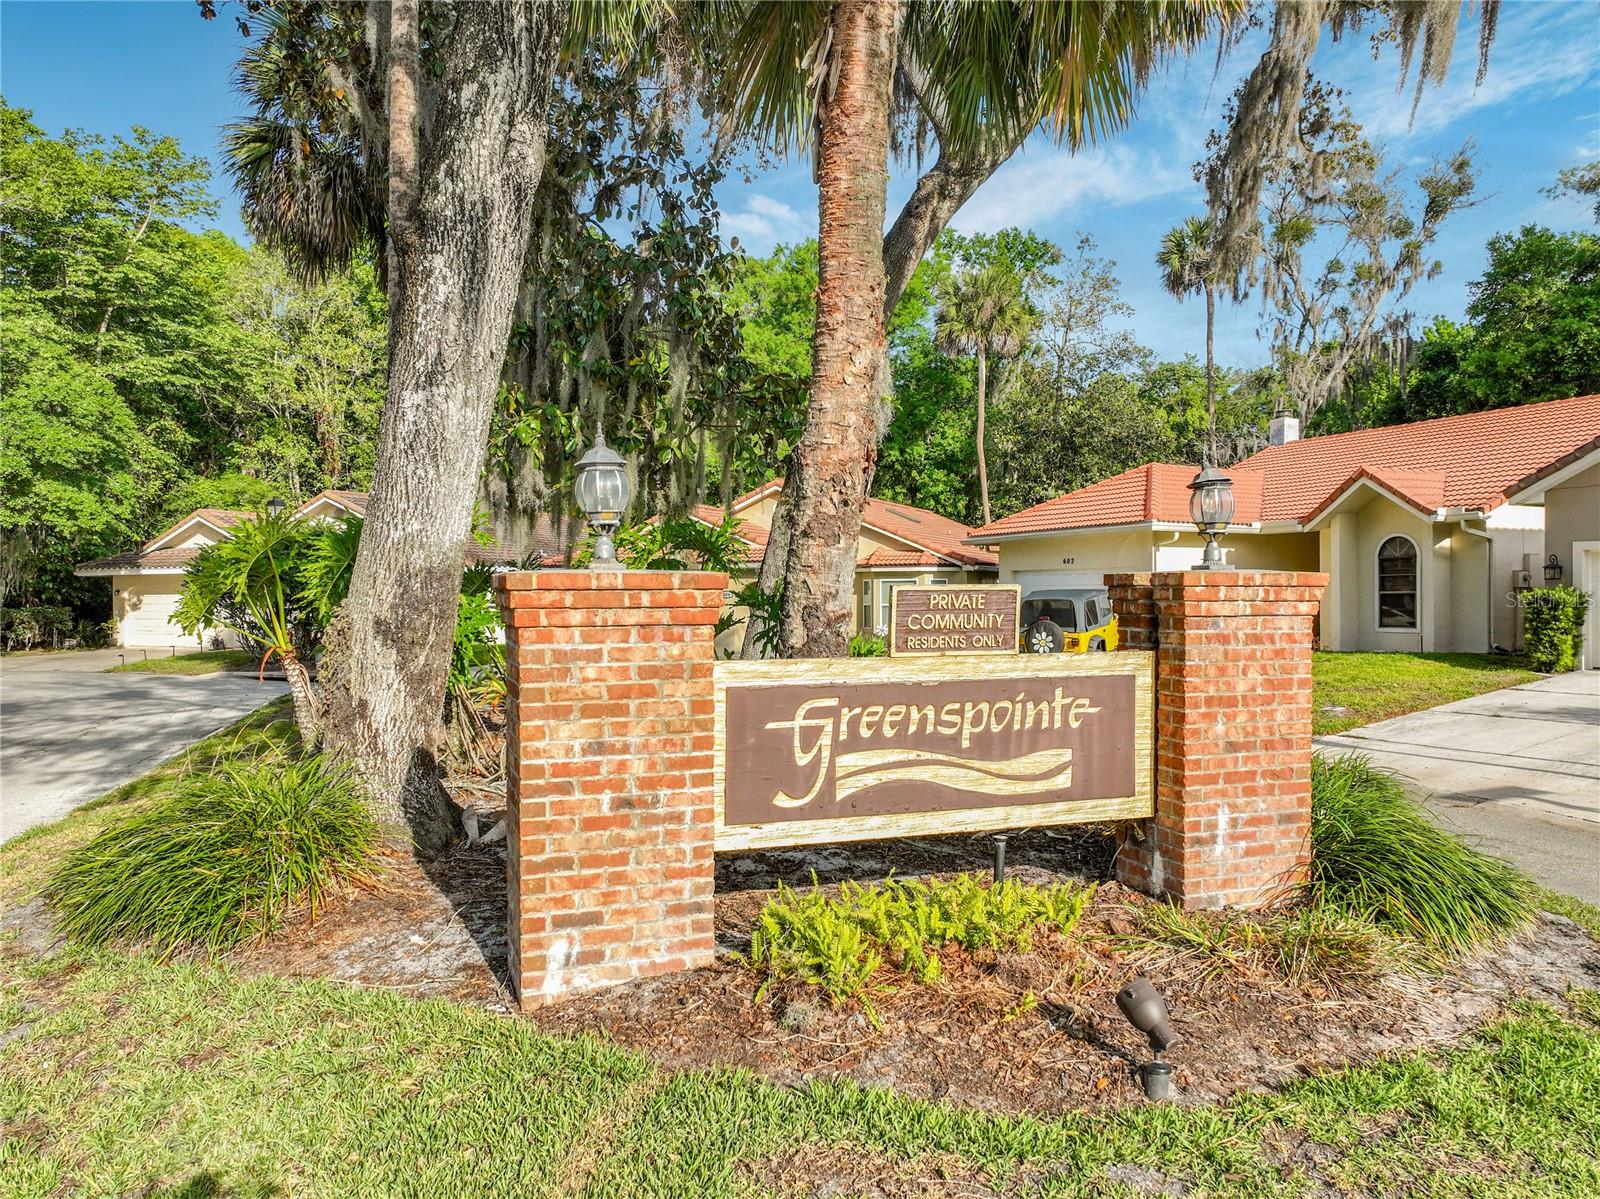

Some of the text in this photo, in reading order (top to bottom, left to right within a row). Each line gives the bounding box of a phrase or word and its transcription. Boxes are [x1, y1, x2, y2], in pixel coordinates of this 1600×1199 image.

[1062, 557, 1075, 565] 602
[929, 594, 985, 609] PRIVATE
[907, 613, 1005, 630] COMMUNITY
[907, 635, 1004, 649] RESIDENTS ONLY
[765, 686, 1101, 808] Greenspointe
